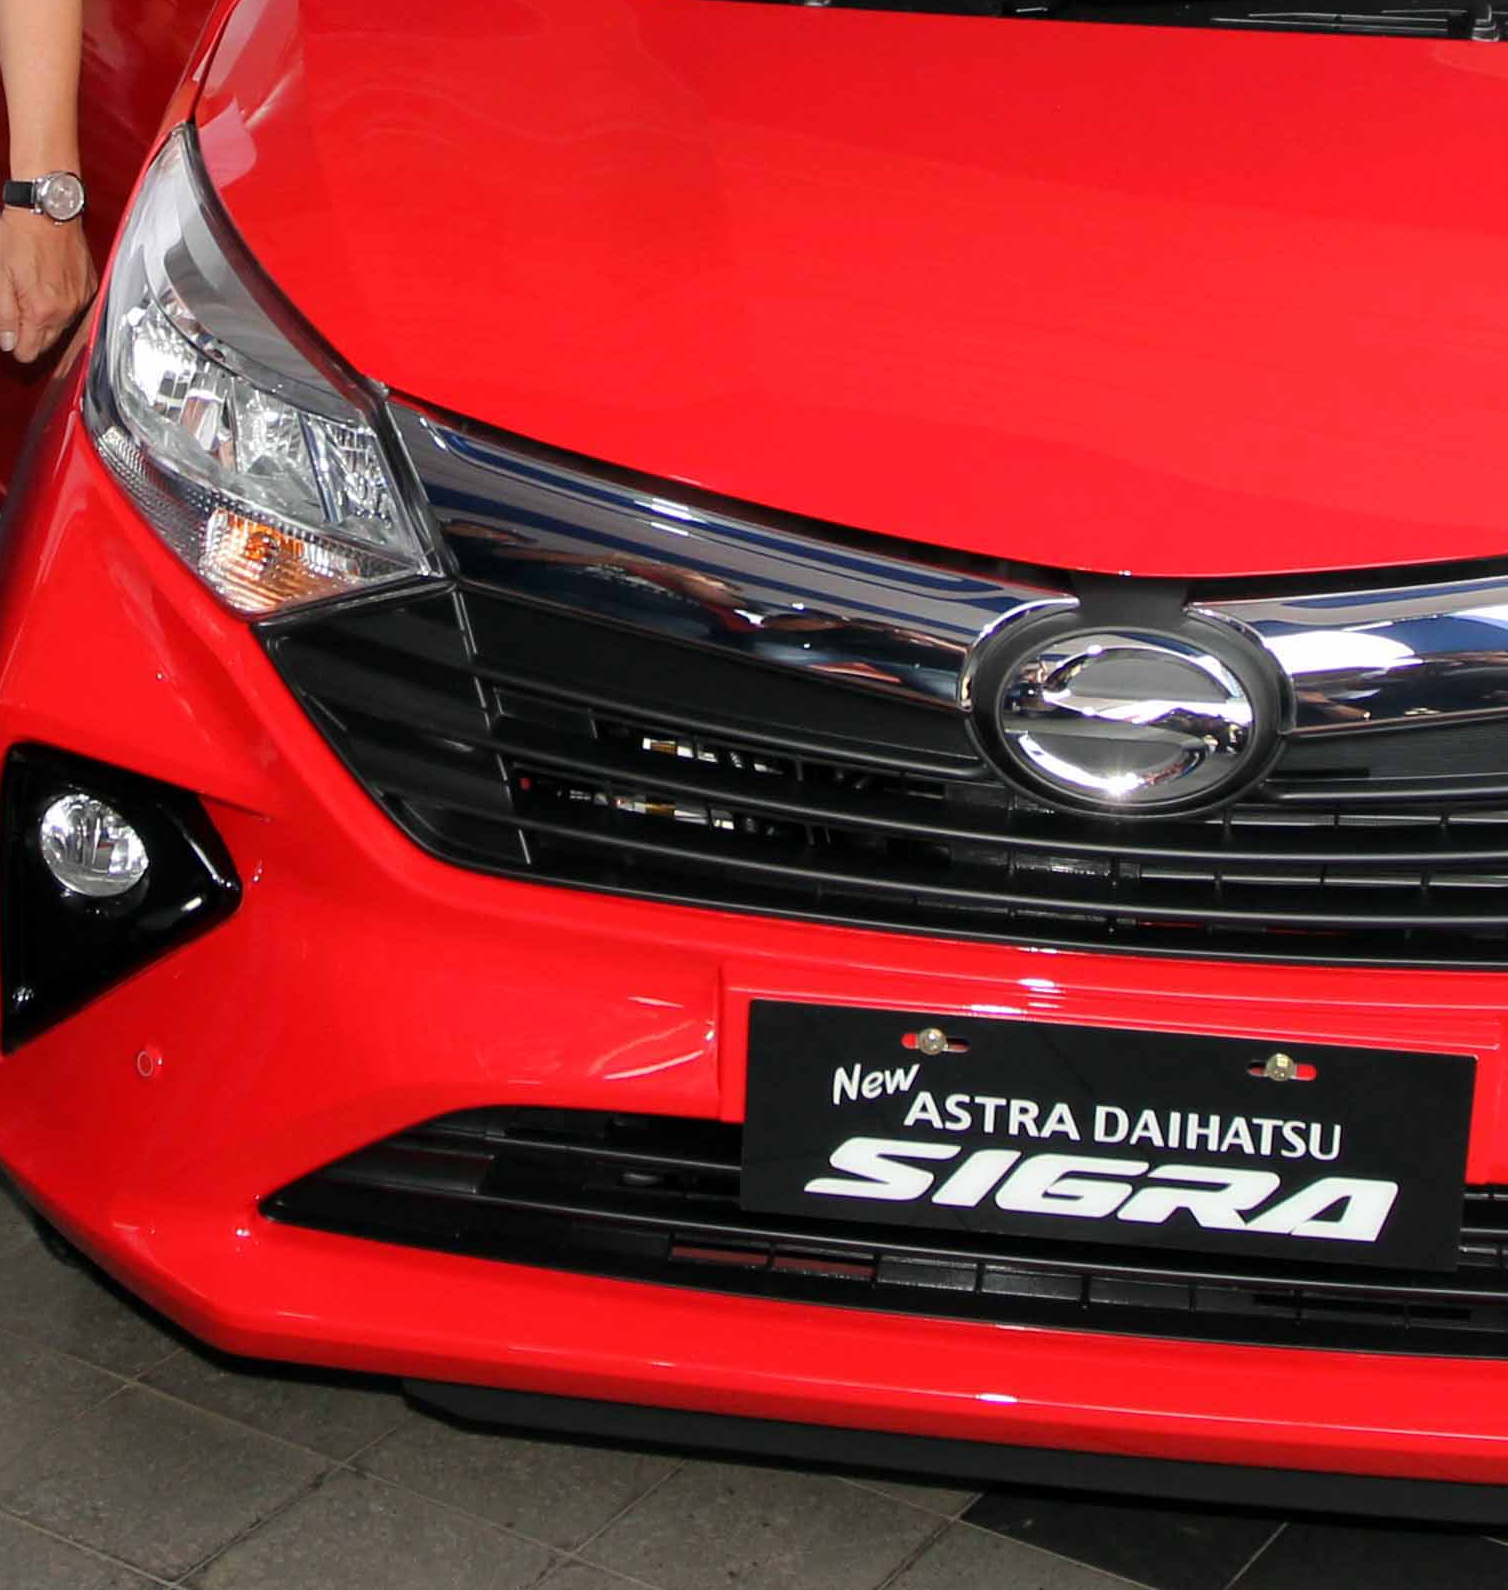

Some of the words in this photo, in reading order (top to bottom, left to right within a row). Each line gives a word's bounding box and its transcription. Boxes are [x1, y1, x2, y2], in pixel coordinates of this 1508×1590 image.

[832, 1062, 920, 1105] New
[902, 1090, 1081, 1141] ASTRA
[1093, 1104, 1343, 1162] DAIHATSU
[802, 1135, 1399, 1243] SIGRA
